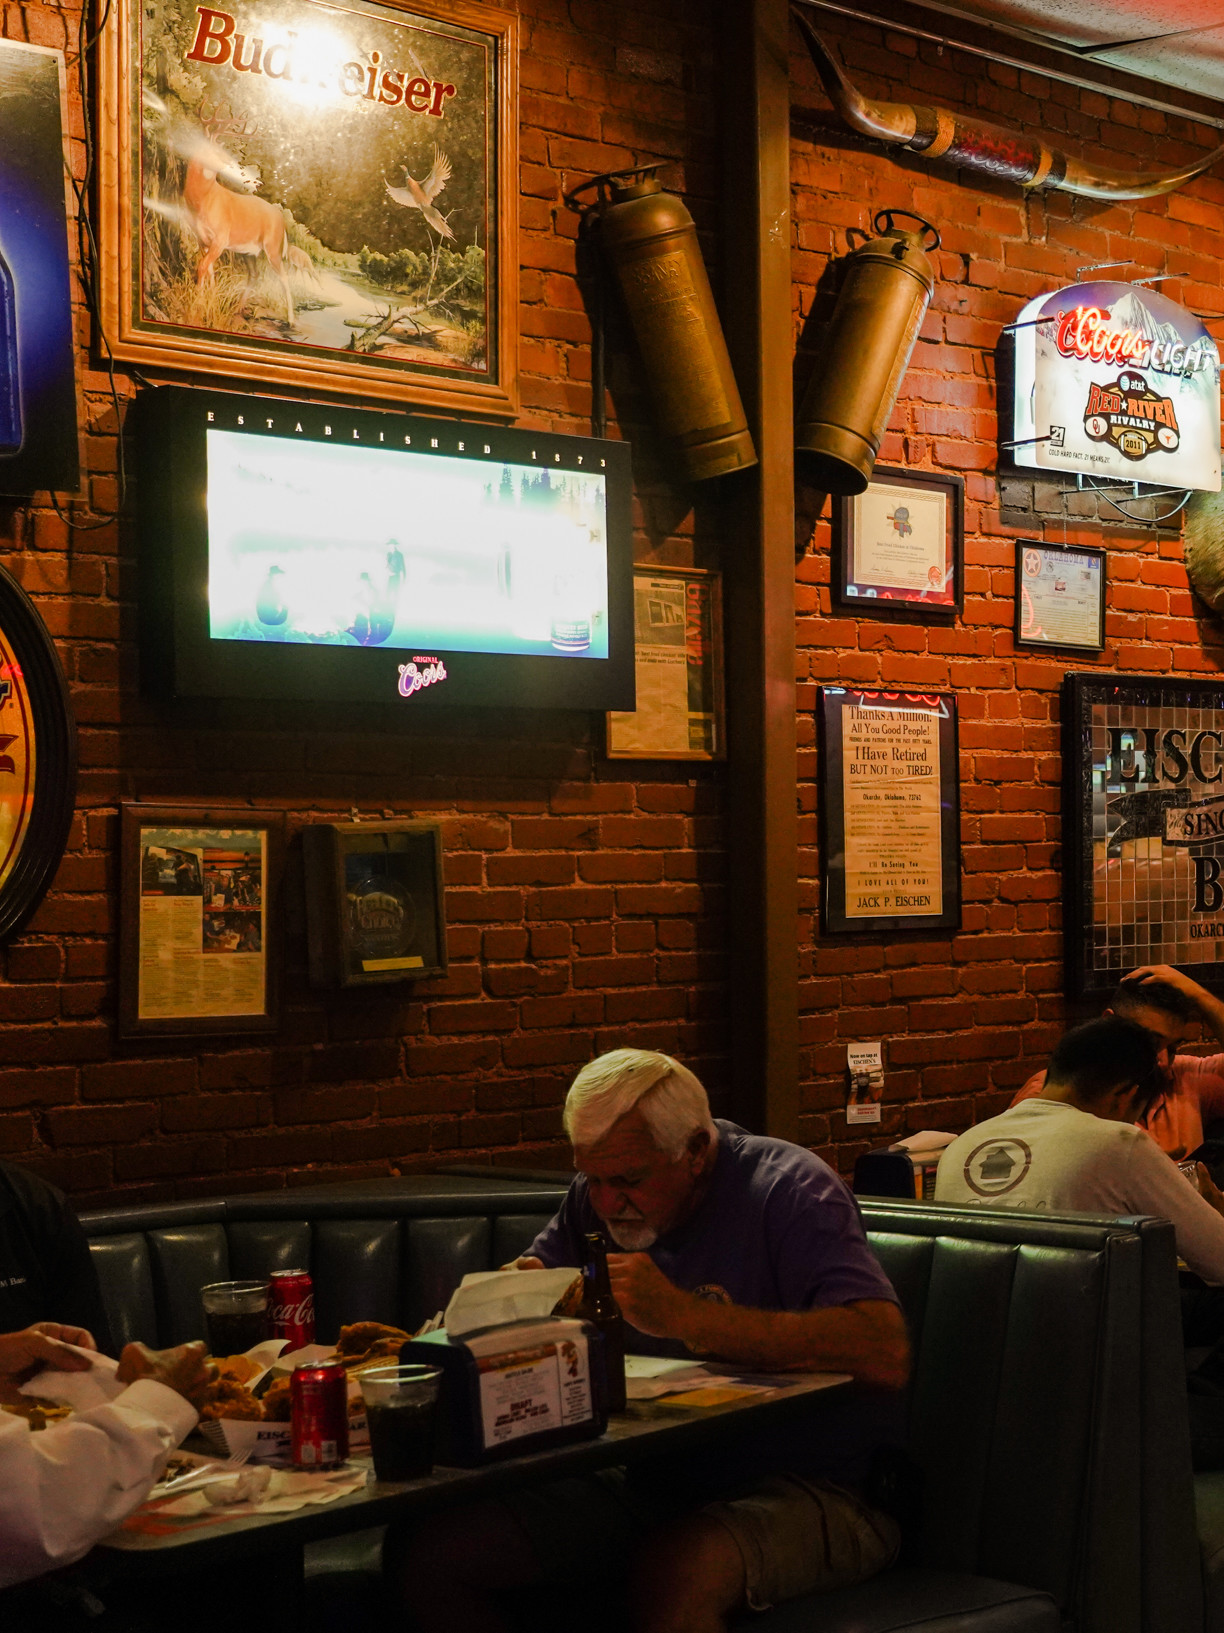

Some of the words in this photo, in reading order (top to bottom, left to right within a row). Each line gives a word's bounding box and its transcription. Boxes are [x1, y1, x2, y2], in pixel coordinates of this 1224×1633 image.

[185, 6, 456, 119] Budeiser
[1057, 305, 1147, 363] Coors
[1086, 384, 1120, 415] RED
[1127, 397, 1179, 430] RIVER
[1110, 415, 1155, 430] RIVALRY
[207, 412, 492, 454] ESTABLISHED
[531, 451, 607, 467] 1873
[1051, 427, 1065, 440] 21
[1126, 440, 1141, 448] 2011
[1049, 449, 1060, 457] COLD
[1060, 450, 1072, 458] HARD
[1090, 455, 1104, 463] MEANS
[1043, 550, 1084, 564] OKLAHOMA
[398, 661, 447, 697] Coors
[849, 705, 885, 721] Thanks
[887, 708, 895, 721] A
[851, 723, 862, 733] All
[865, 723, 879, 734] You
[882, 724, 902, 734] Good
[903, 725, 930, 737] People!
[856, 746, 859, 760] I
[862, 746, 887, 760] Have
[892, 747, 927, 761] Retired
[850, 764, 867, 774] BUT
[870, 765, 888, 775] NOT
[906, 765, 933, 775] TIRED!
[857, 897, 880, 908] JACK
[884, 897, 892, 907] P.
[895, 896, 930, 907] EISCHEN
